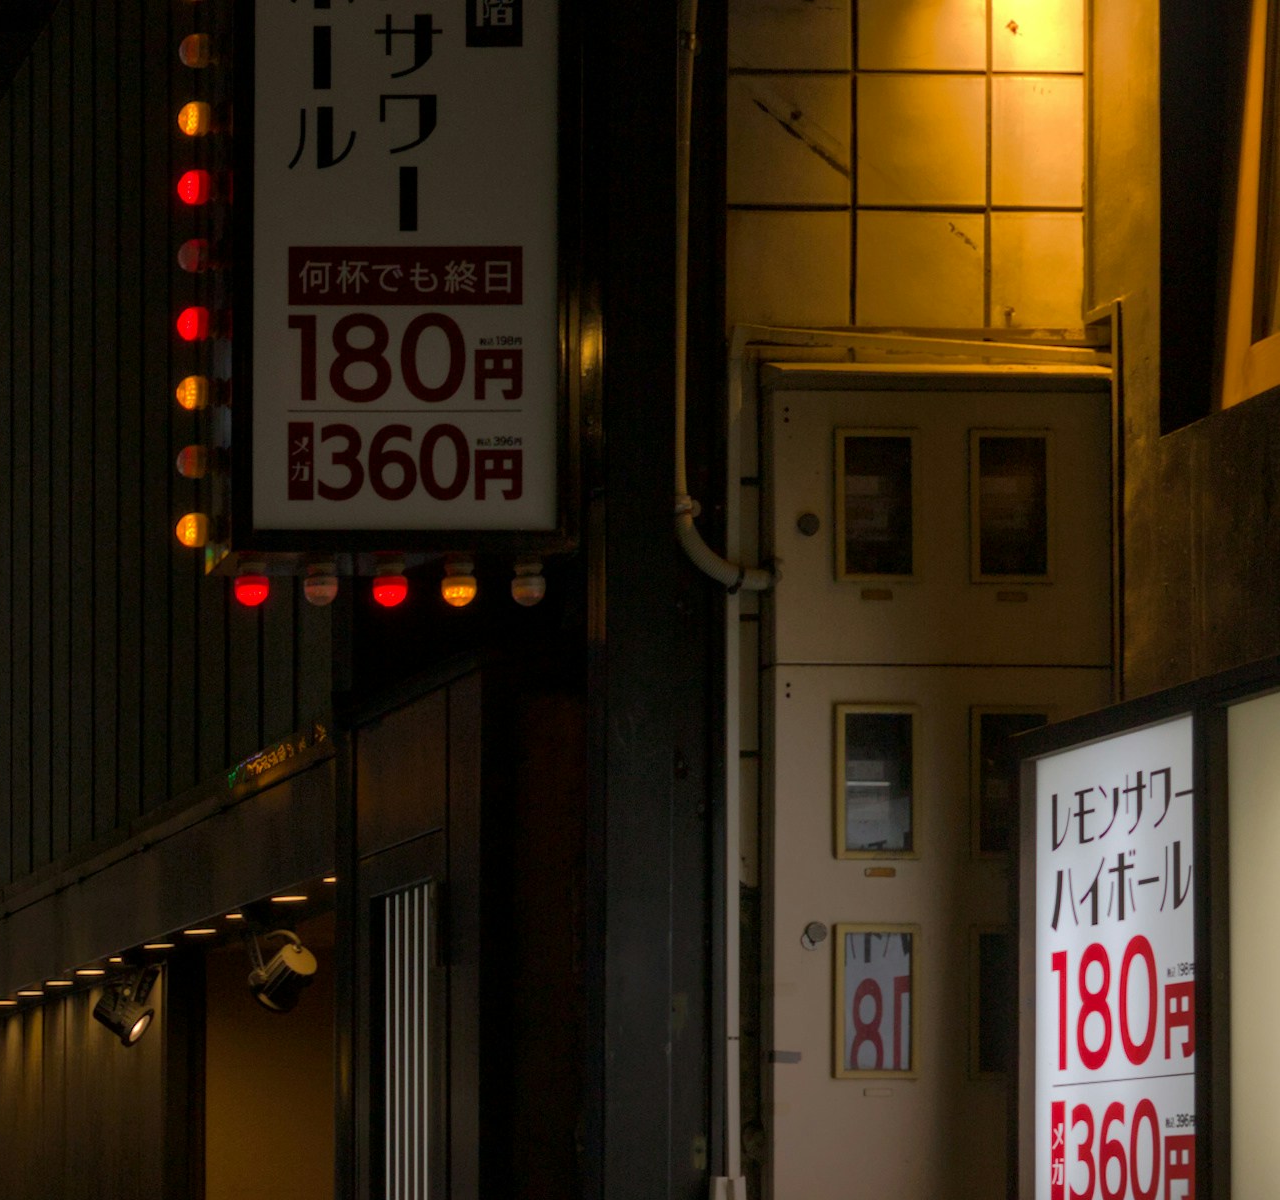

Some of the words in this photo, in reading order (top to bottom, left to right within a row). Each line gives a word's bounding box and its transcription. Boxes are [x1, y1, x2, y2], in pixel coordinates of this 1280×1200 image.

[287, 0, 357, 170] ール
[298, 259, 515, 296] 何杯でも終日
[1051, 766, 1194, 852] レモンサワー
[1050, 840, 1193, 932] ハイボール
